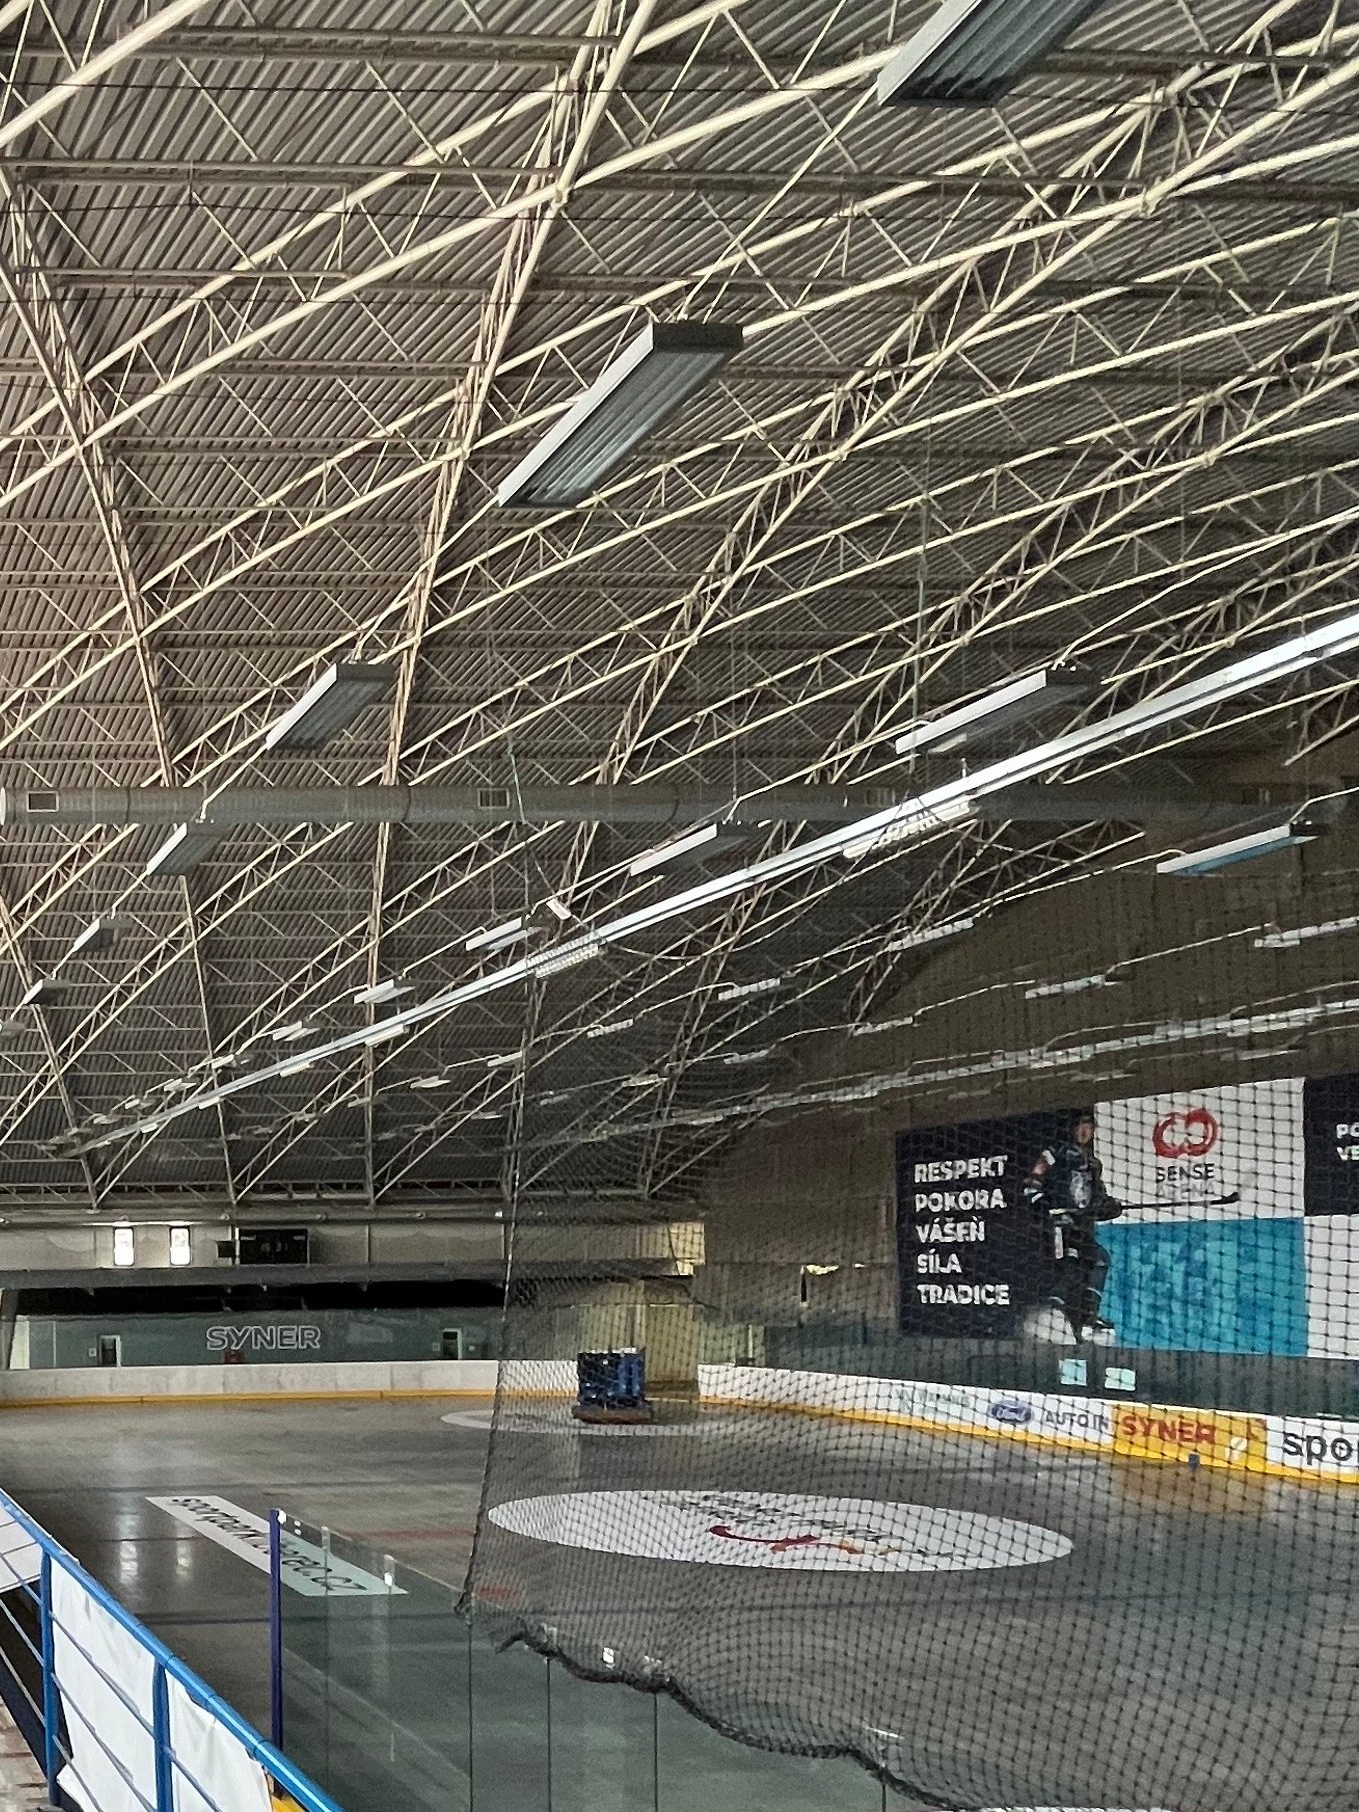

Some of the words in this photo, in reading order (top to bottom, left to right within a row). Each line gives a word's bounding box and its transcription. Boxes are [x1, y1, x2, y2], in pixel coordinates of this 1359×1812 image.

[914, 1154, 1008, 1183] RESPEKT
[1155, 1163, 1215, 1183] SENSE
[915, 1188, 1007, 1212] POKORA
[915, 1215, 985, 1243] VÁŠEŇ
[917, 1248, 962, 1273] SÍLA
[917, 1284, 1010, 1305] TRADICE
[206, 1326, 321, 1350] SYNER
[1121, 1414, 1216, 1445] SYNER
[1282, 1431, 1359, 1466] spo
